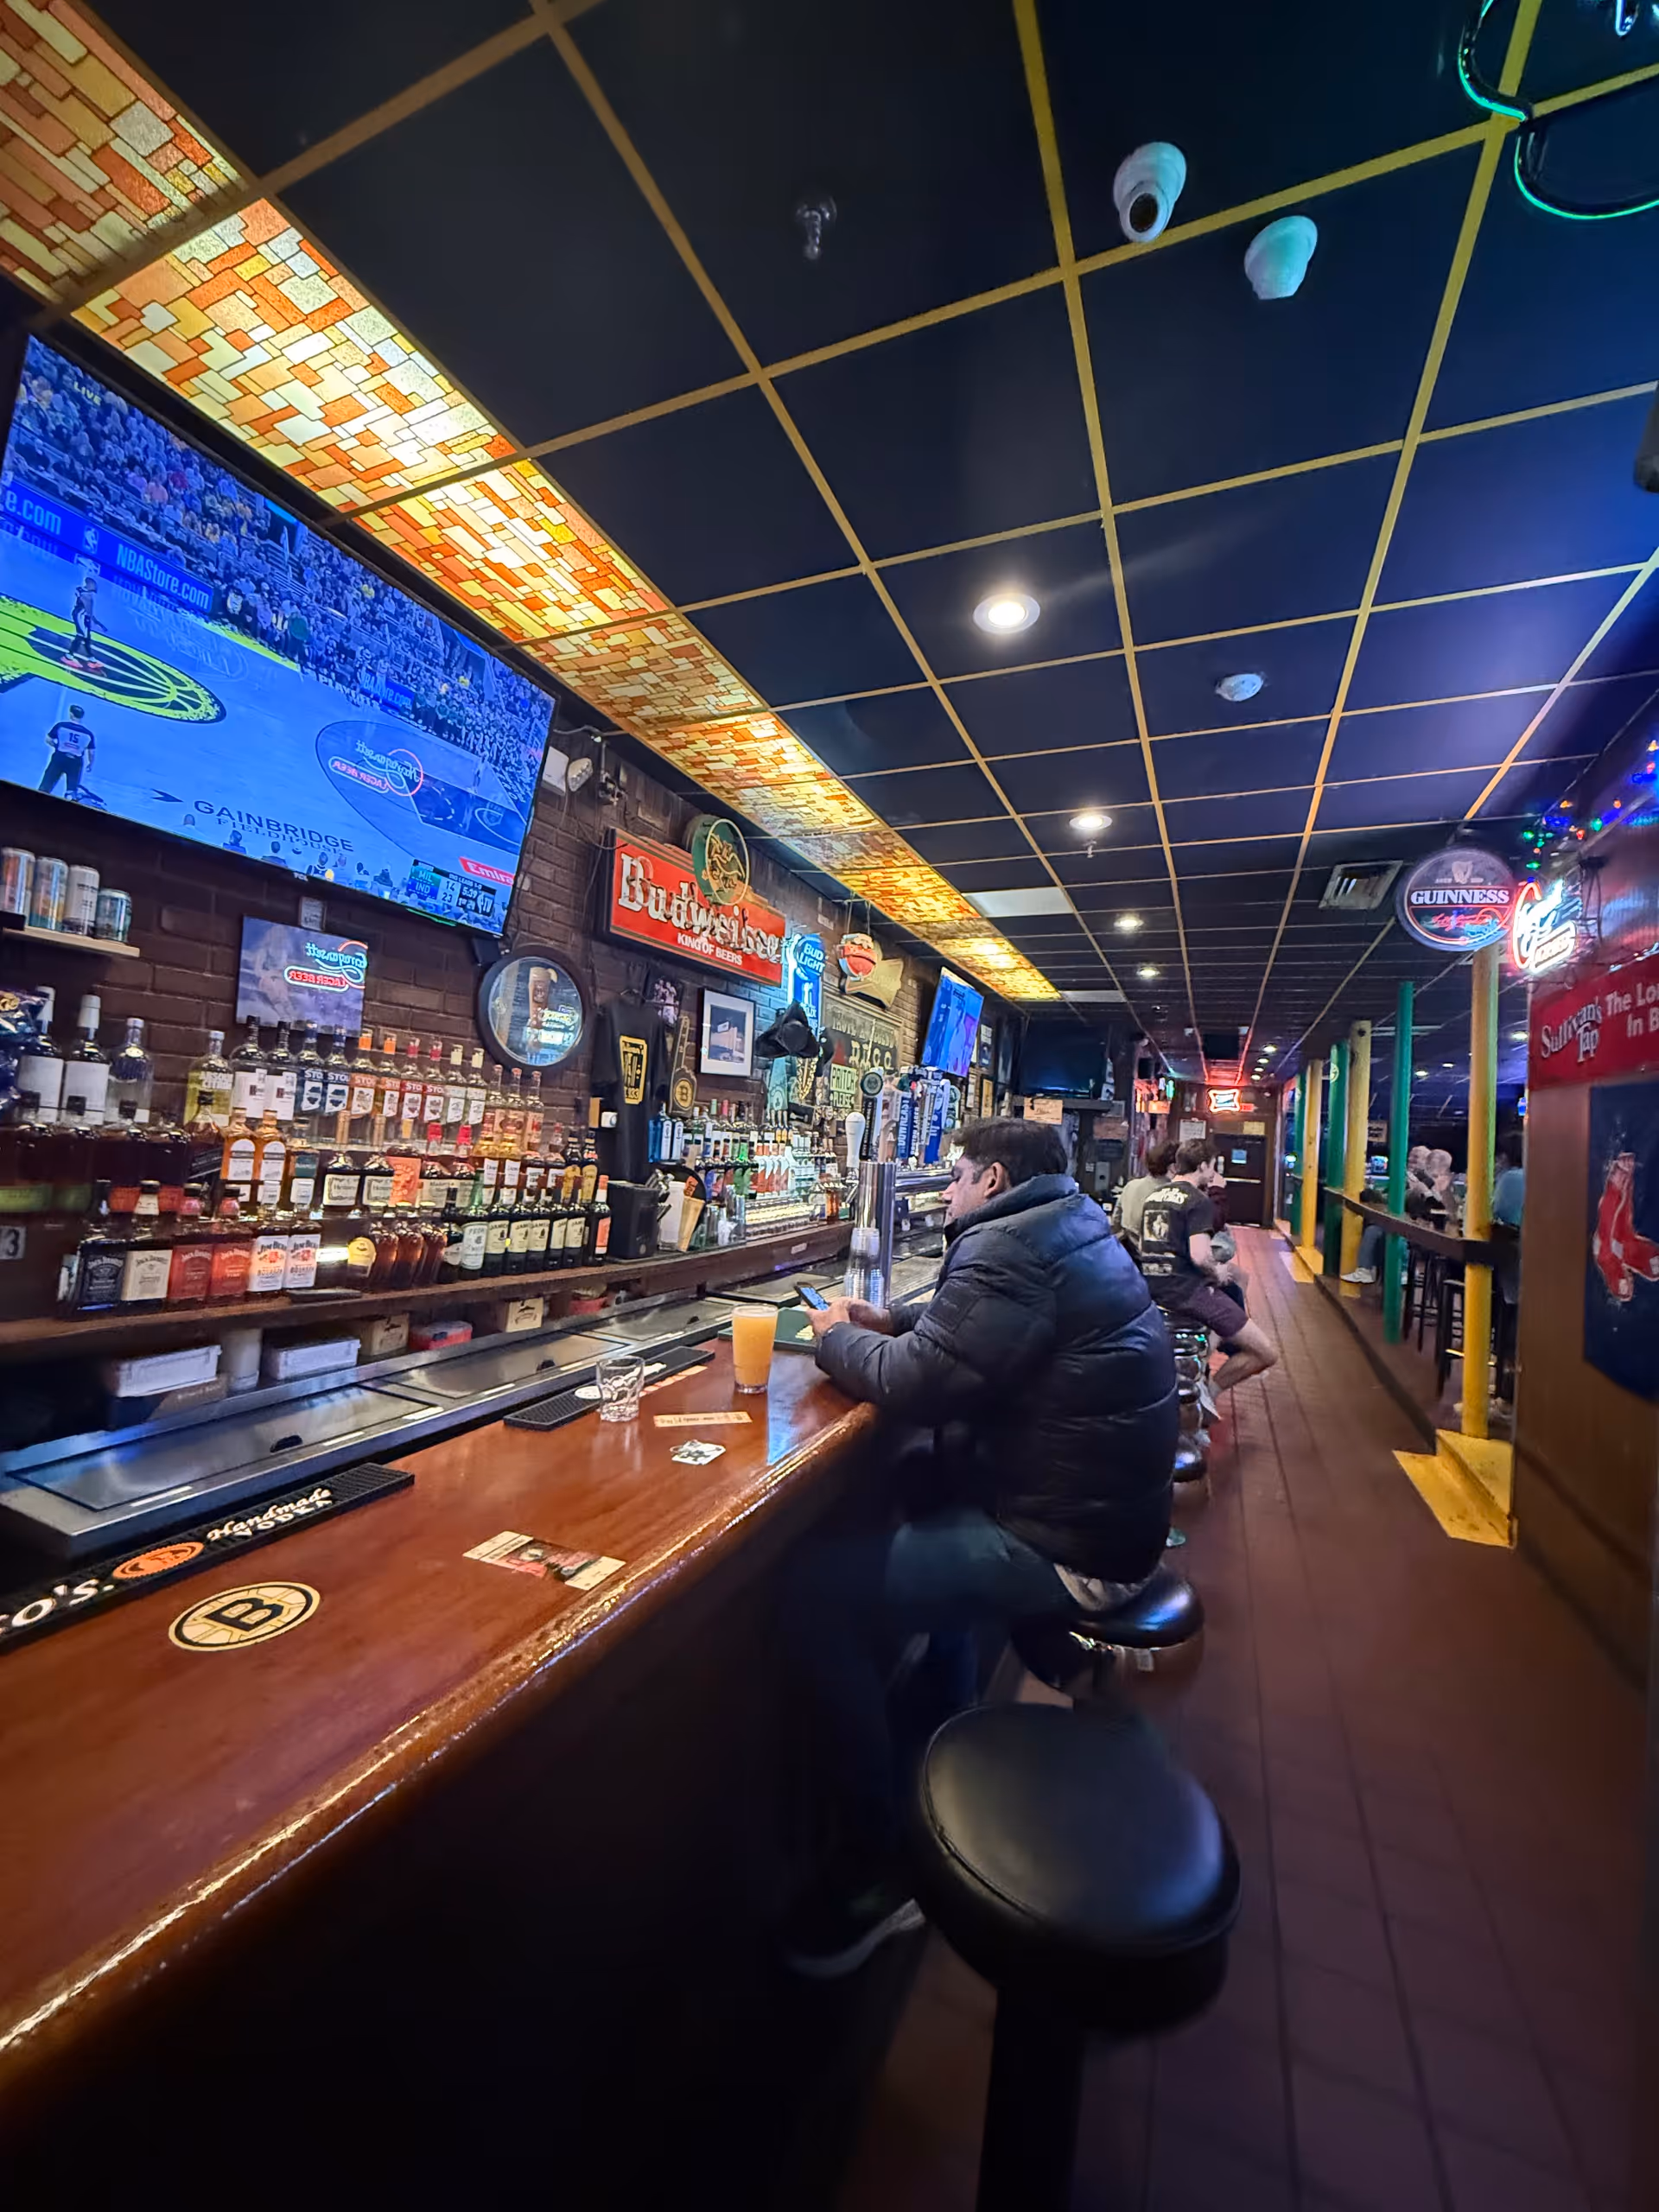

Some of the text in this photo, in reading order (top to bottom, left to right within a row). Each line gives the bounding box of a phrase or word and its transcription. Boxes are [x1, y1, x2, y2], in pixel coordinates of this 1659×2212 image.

[73, 381, 101, 405] LIVE
[117, 543, 210, 610] NBAStore.com
[69, 732, 80, 743] 15
[194, 800, 354, 852] GAINBRIDGE
[416, 882, 430, 893] IND
[418, 871, 432, 881] MIL
[446, 880, 455, 892] 14
[442, 893, 452, 903] 23
[1410, 889, 1510, 905] GUINNESS
[677, 932, 743, 966] KING OF BEERS
[804, 943, 824, 961] BUD
[798, 952, 826, 973] LIGHT
[1605, 990, 1632, 1016] The
[1541, 995, 1602, 1058] Sullivan's
[1626, 1013, 1643, 1039] In
[1576, 1021, 1599, 1063] Tap
[207, 1487, 333, 1541] Handmade
[232, 1499, 334, 1538] VODKA
[207, 1597, 284, 1631] B
